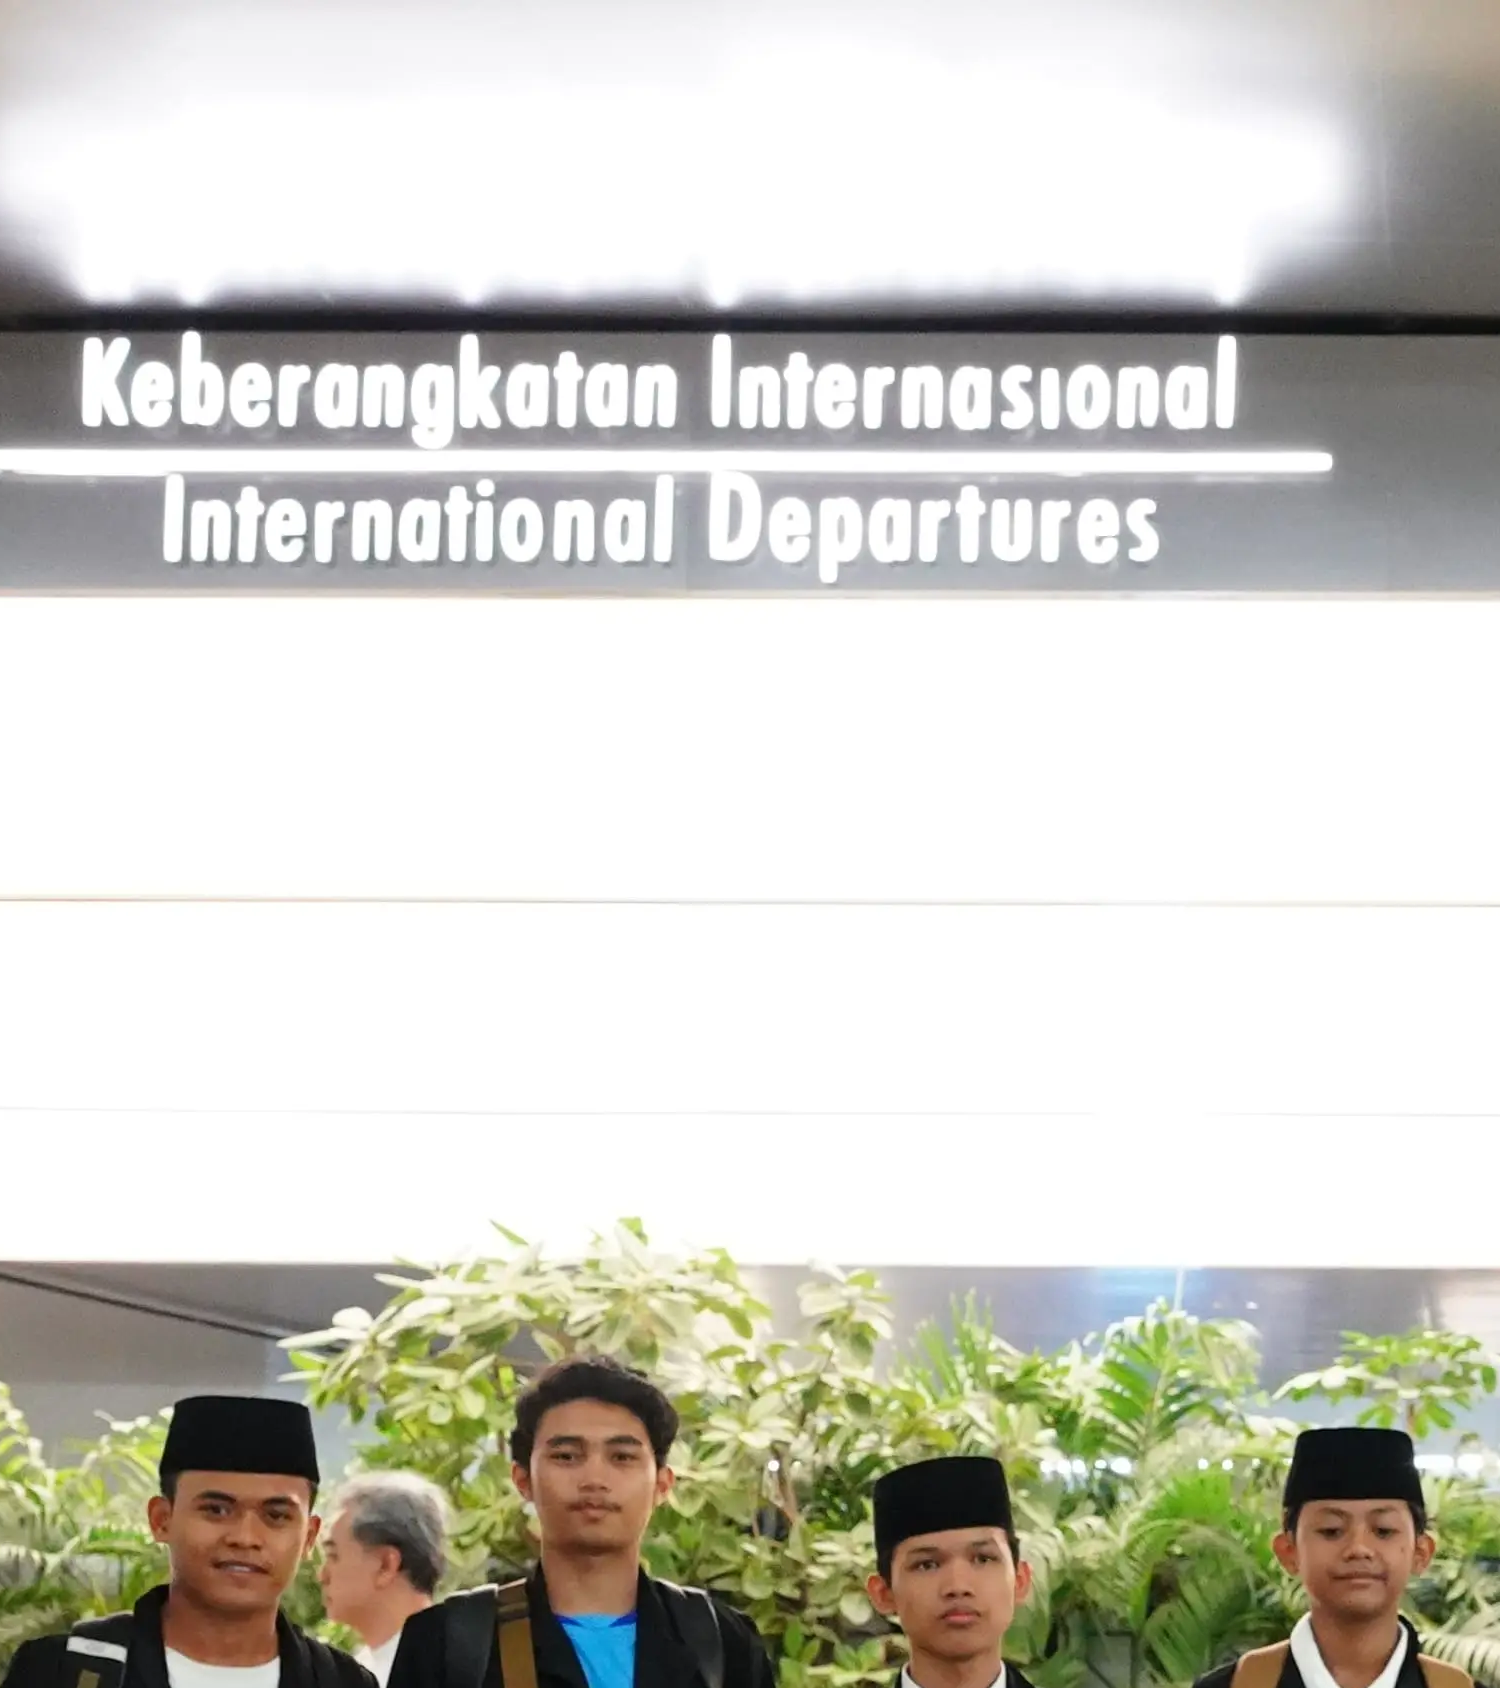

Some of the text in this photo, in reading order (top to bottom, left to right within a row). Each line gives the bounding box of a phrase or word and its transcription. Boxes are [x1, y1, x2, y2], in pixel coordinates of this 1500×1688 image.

[81, 331, 1237, 449] Keberangkatan Internasional
[163, 470, 1159, 584] International Departures
